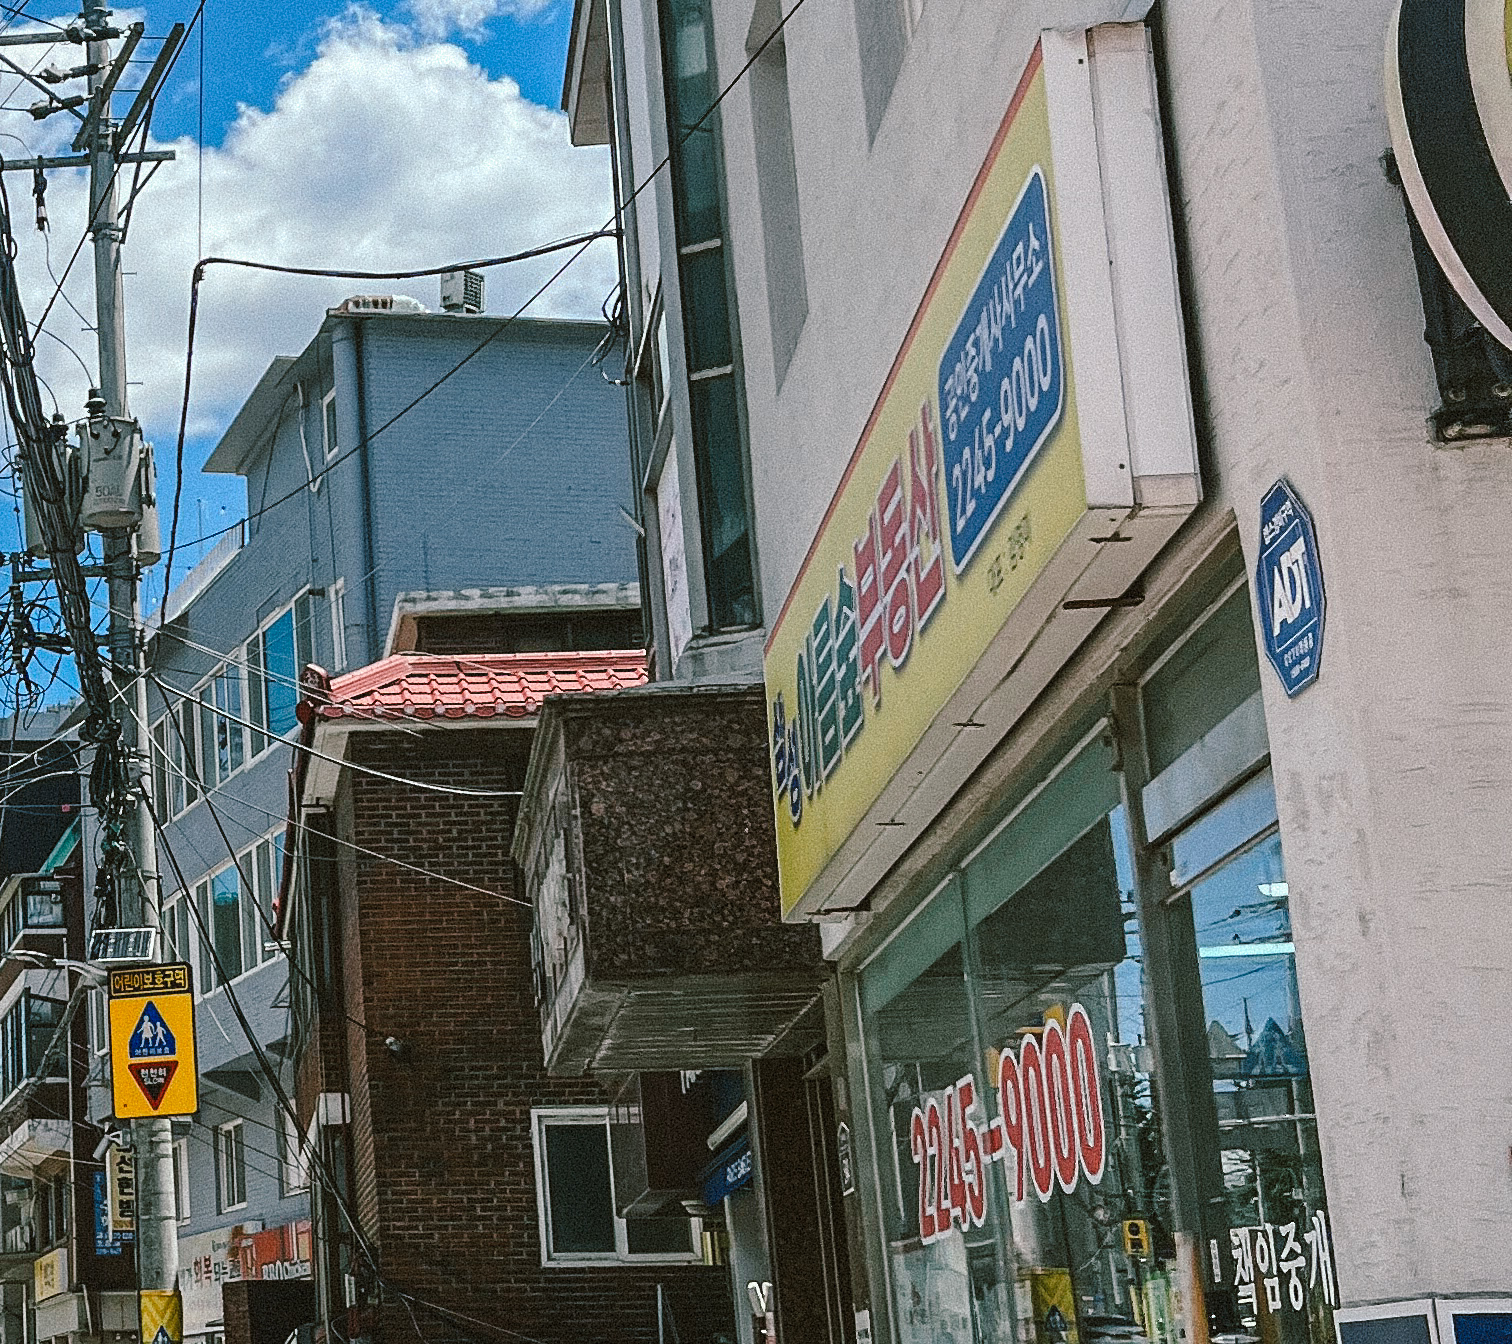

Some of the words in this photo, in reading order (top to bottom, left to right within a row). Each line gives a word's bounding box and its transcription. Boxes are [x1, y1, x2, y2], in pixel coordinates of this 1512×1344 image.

[945, 222, 1043, 441] 공인중개사사무소
[953, 314, 1051, 535] 2245-9000
[1273, 536, 1310, 636] ADT
[114, 969, 185, 991] 어린이보호구역
[911, 1002, 1105, 1246] 2245-9000
[1230, 1209, 1335, 1327] 책임중개
